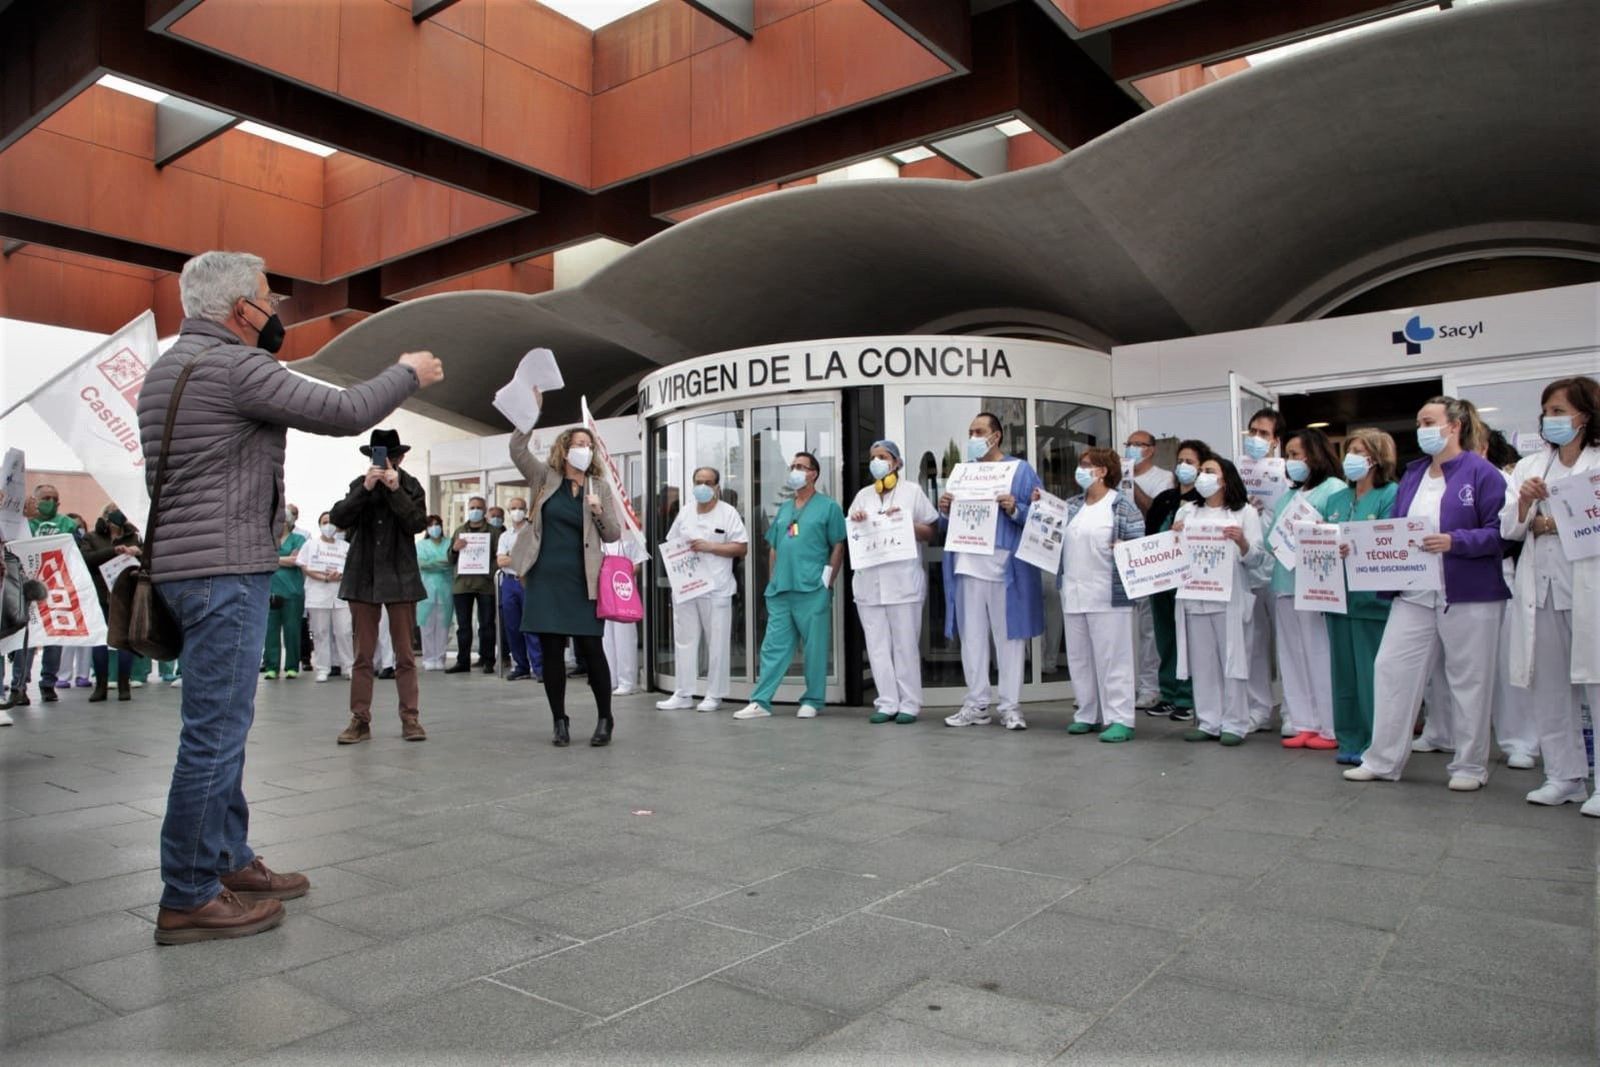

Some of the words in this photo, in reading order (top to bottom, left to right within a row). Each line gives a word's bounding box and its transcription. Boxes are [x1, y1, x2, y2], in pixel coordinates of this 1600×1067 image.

[1439, 321, 1483, 338] Sacyl
[658, 362, 737, 404] VIRGEN
[749, 355, 790, 387] DE
[804, 350, 847, 381] LA
[858, 346, 1011, 378] CONCHA
[80, 386, 139, 453] Castilla
[1141, 540, 1160, 552] SOY
[1375, 537, 1393, 546] SOY
[1128, 547, 1183, 569] CELADOR/A
[1366, 549, 1409, 561] TÉCNIC@
